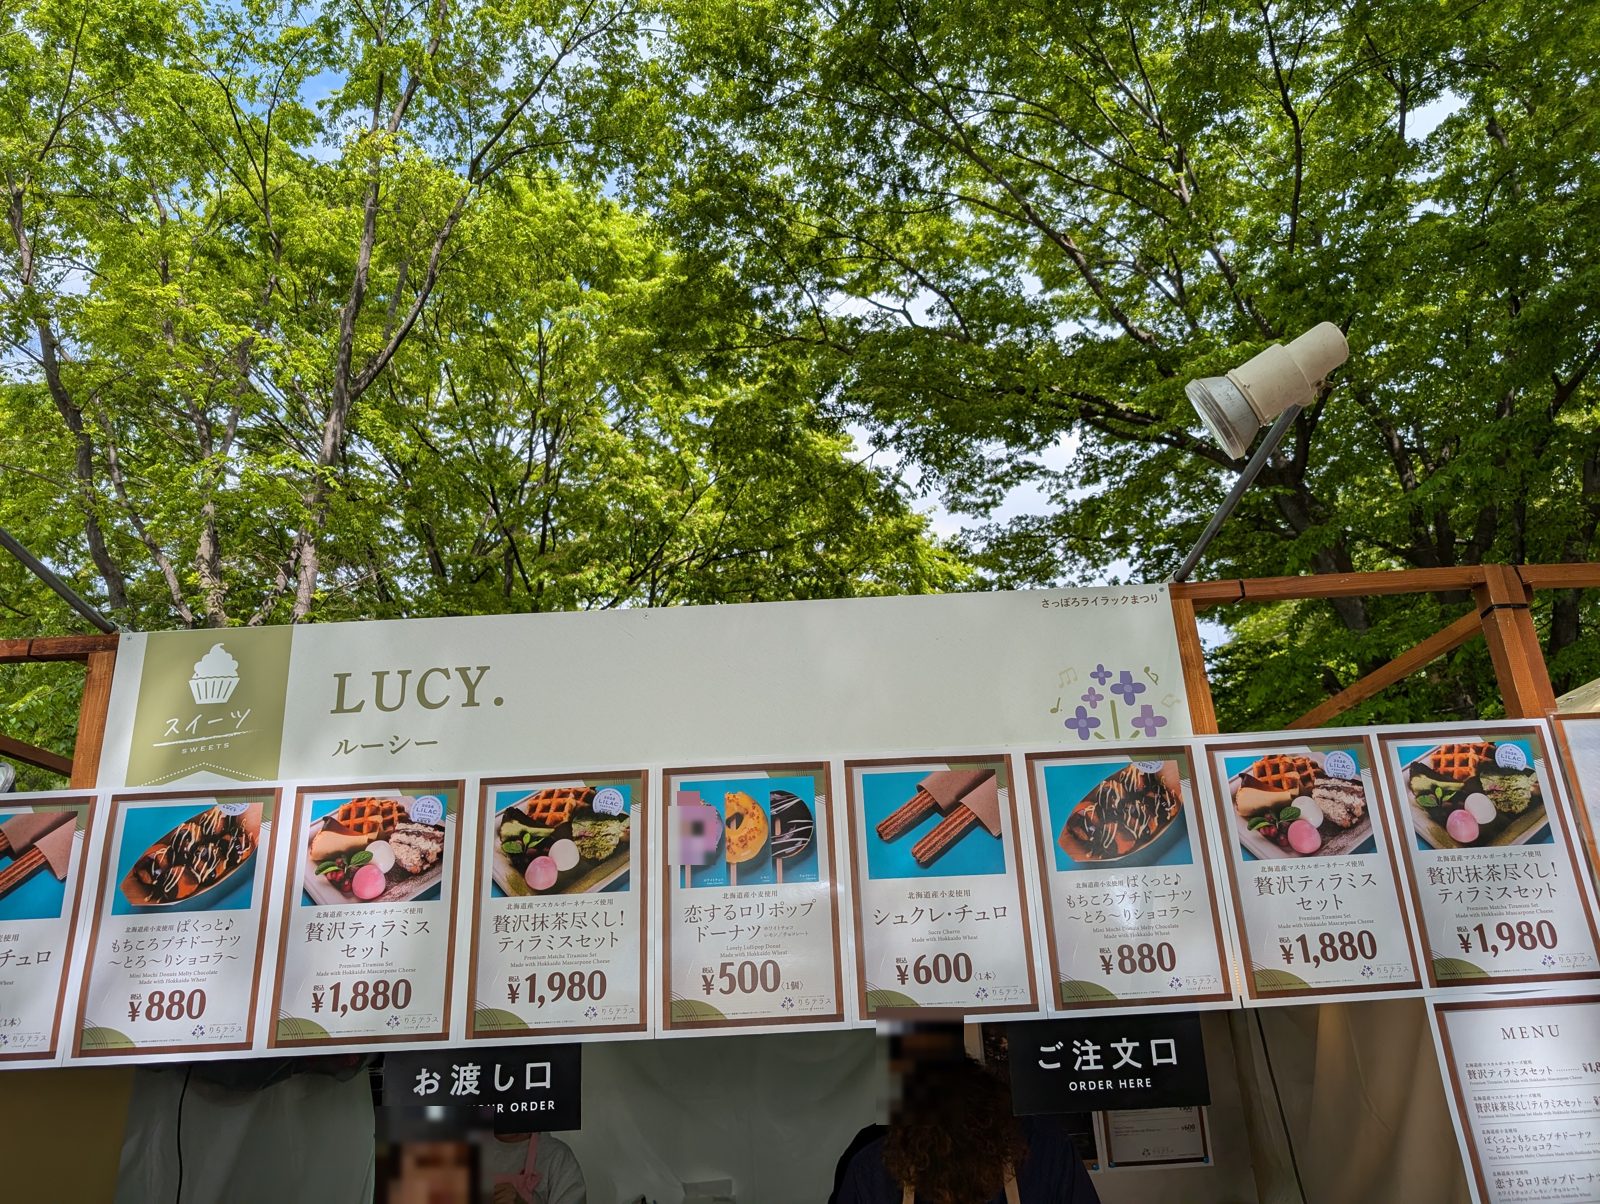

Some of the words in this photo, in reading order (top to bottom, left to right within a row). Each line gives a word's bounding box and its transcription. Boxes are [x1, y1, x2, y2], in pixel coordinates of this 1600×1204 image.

[1042, 594, 1158, 608] さっぽろライラックまつり
[330, 666, 504, 714] LUCY.
[164, 708, 251, 737] スイーツ
[181, 742, 230, 754] SWEETS
[332, 735, 438, 757] ルーシー
[1254, 873, 1377, 896] 贅沢ティラミス
[1427, 862, 1558, 885] 贅沢抹茶尽くし！
[723, 890, 777, 899] 北海道産小麦使用
[908, 890, 970, 899] 北海道産小麦使用
[1066, 890, 1192, 908] もちころプチドーナツ
[1296, 894, 1343, 912] セット
[1438, 882, 1557, 904] ティラミスセット
[492, 910, 624, 934] 贅沢抹茶尽くし！
[684, 899, 816, 923] 恋するロリポップ
[873, 904, 1007, 925] シュクレ・チュロ
[305, 920, 430, 943] 贅沢ティラミス
[499, 932, 619, 953] ティラミスセット
[696, 925, 761, 943] ドーナツ
[1457, 920, 1558, 958] ¥1,980
[112, 935, 241, 952] もちころプチドーナツ
[341, 941, 389, 959] セット
[1280, 930, 1377, 968] ¥1,880
[896, 952, 972, 985] ¥600
[1100, 942, 1176, 975] ¥880
[702, 960, 780, 995] ¥500
[312, 979, 412, 1017] ¥1,880
[508, 970, 607, 1008] ¥1,980
[128, 989, 207, 1022] ¥880
[1501, 1025, 1560, 1040] MENU
[1038, 1038, 1177, 1071] ご注文口
[413, 1062, 551, 1096] お渡し口
[1467, 1066, 1552, 1080] 贅沢ティラミスセット
[1069, 1080, 1113, 1091] ORDER
[1120, 1078, 1152, 1089] HERE
[510, 1101, 555, 1112] ORDER
